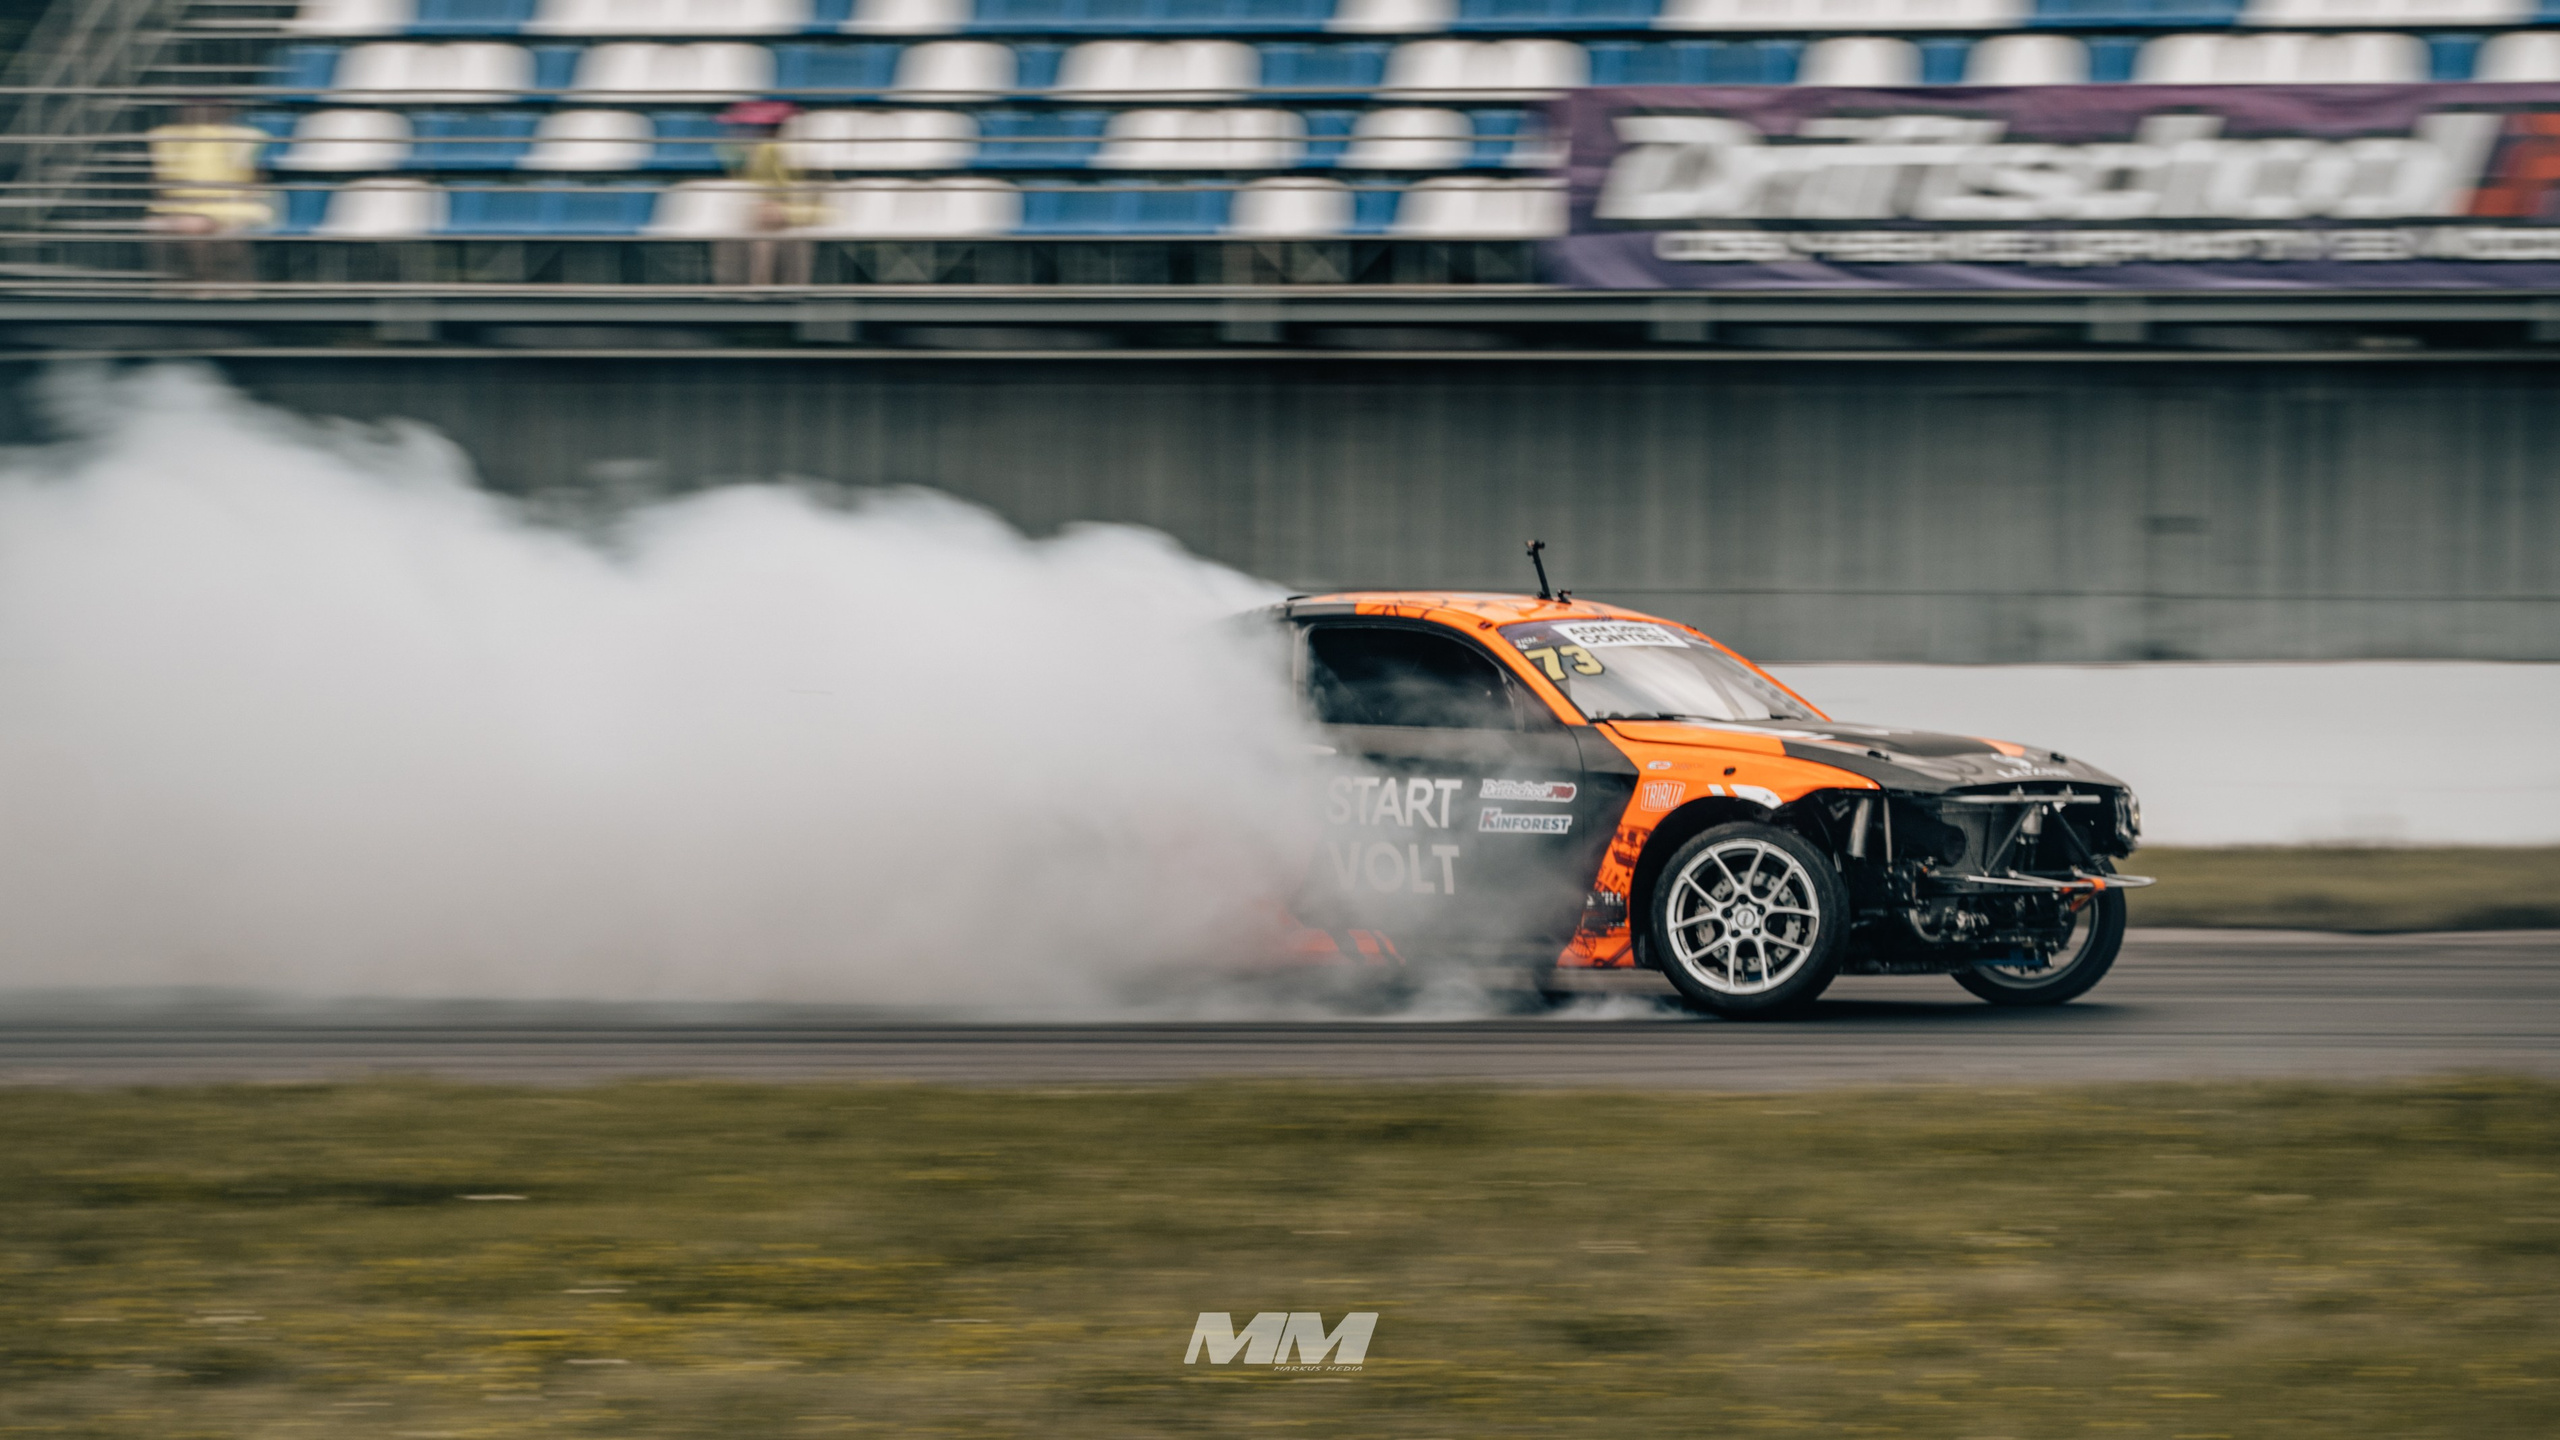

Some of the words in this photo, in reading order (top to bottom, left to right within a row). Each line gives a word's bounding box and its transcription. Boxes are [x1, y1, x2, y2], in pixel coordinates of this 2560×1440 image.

[1580, 634, 1674, 644] CONTEST
[1524, 644, 1604, 680] 73
[1325, 776, 1462, 829] START
[1327, 842, 1460, 895] VOLT
